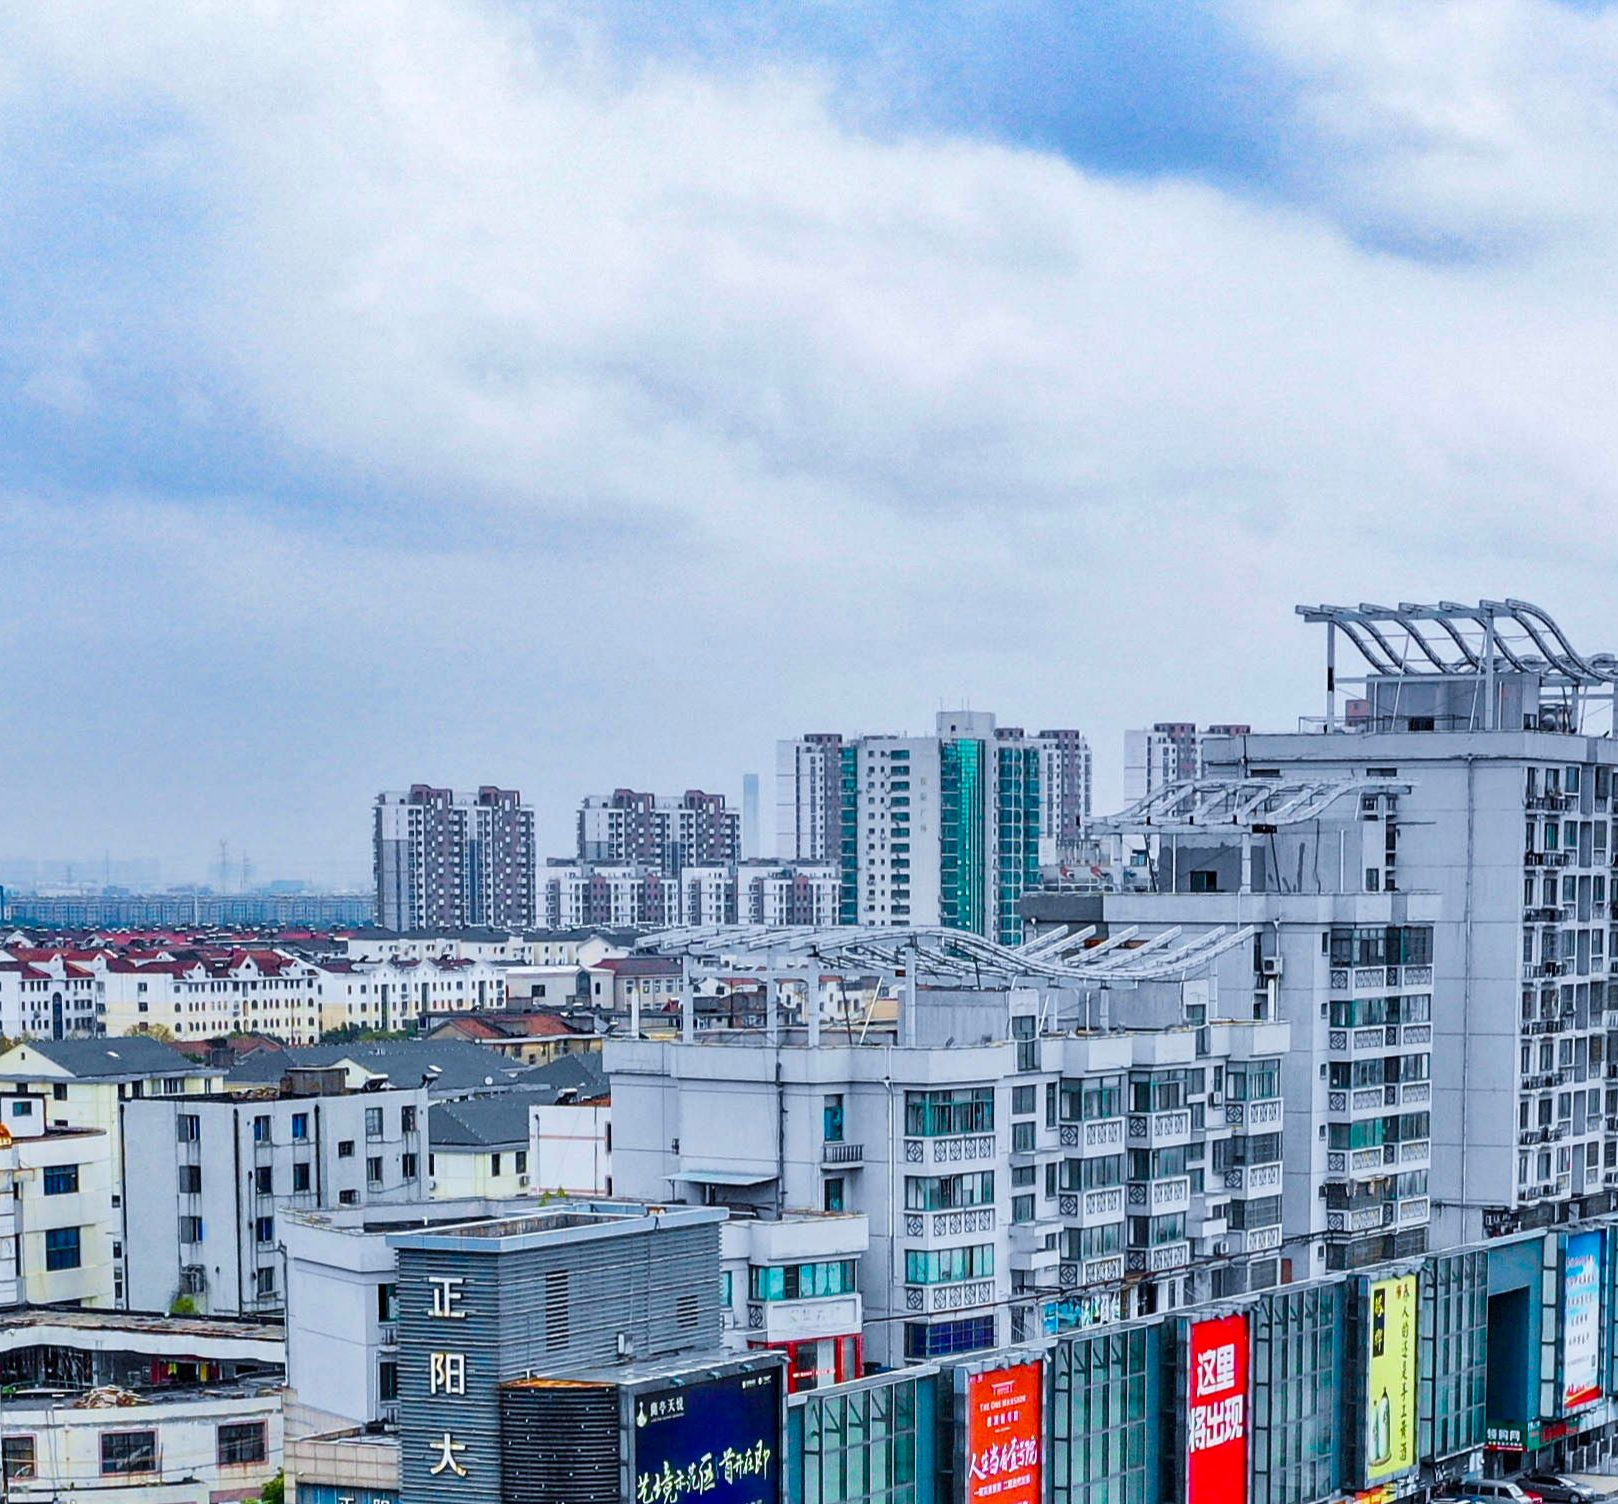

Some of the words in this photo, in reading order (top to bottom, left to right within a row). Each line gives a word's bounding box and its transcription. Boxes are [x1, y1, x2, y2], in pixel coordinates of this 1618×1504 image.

[1196, 1343, 1236, 1398] 这里
[1188, 1393, 1244, 1454] 将出现
